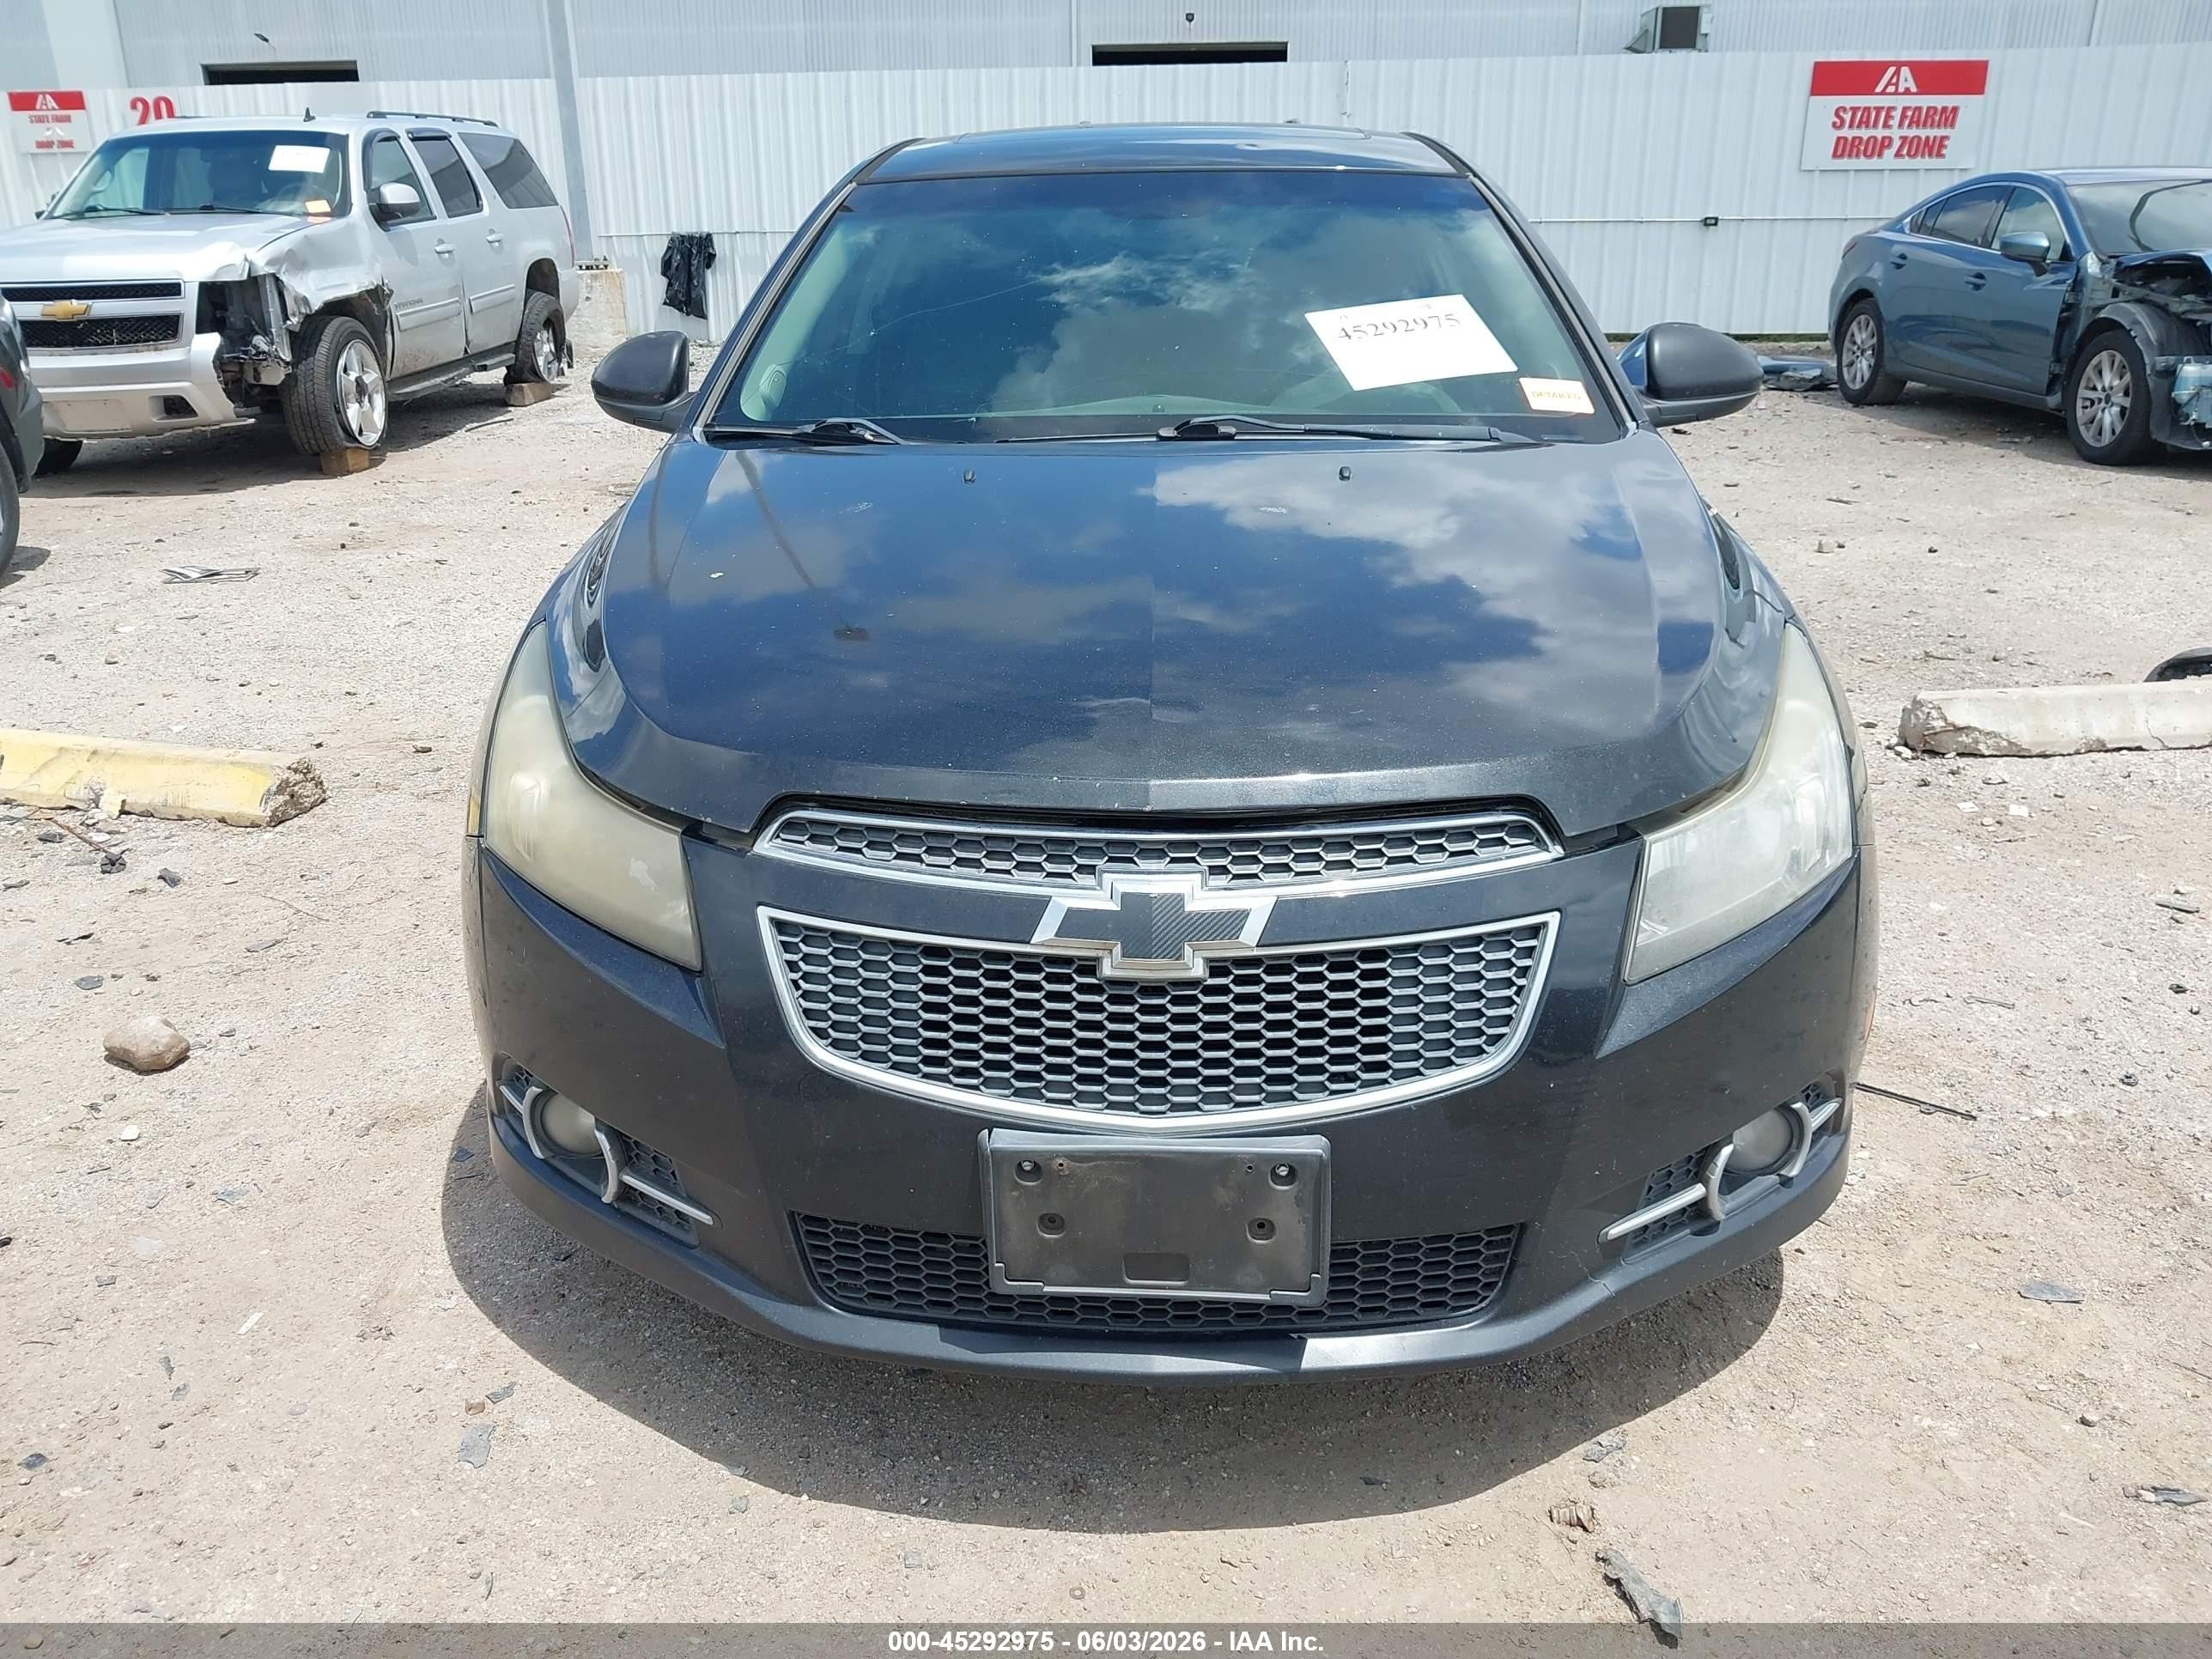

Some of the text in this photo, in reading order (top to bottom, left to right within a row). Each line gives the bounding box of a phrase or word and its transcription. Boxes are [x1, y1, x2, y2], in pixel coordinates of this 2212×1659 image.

[1832, 106, 1960, 130] STATE FARM
[1832, 136, 1950, 160] DROP ZONE
[1338, 313, 1462, 340] 45292975
